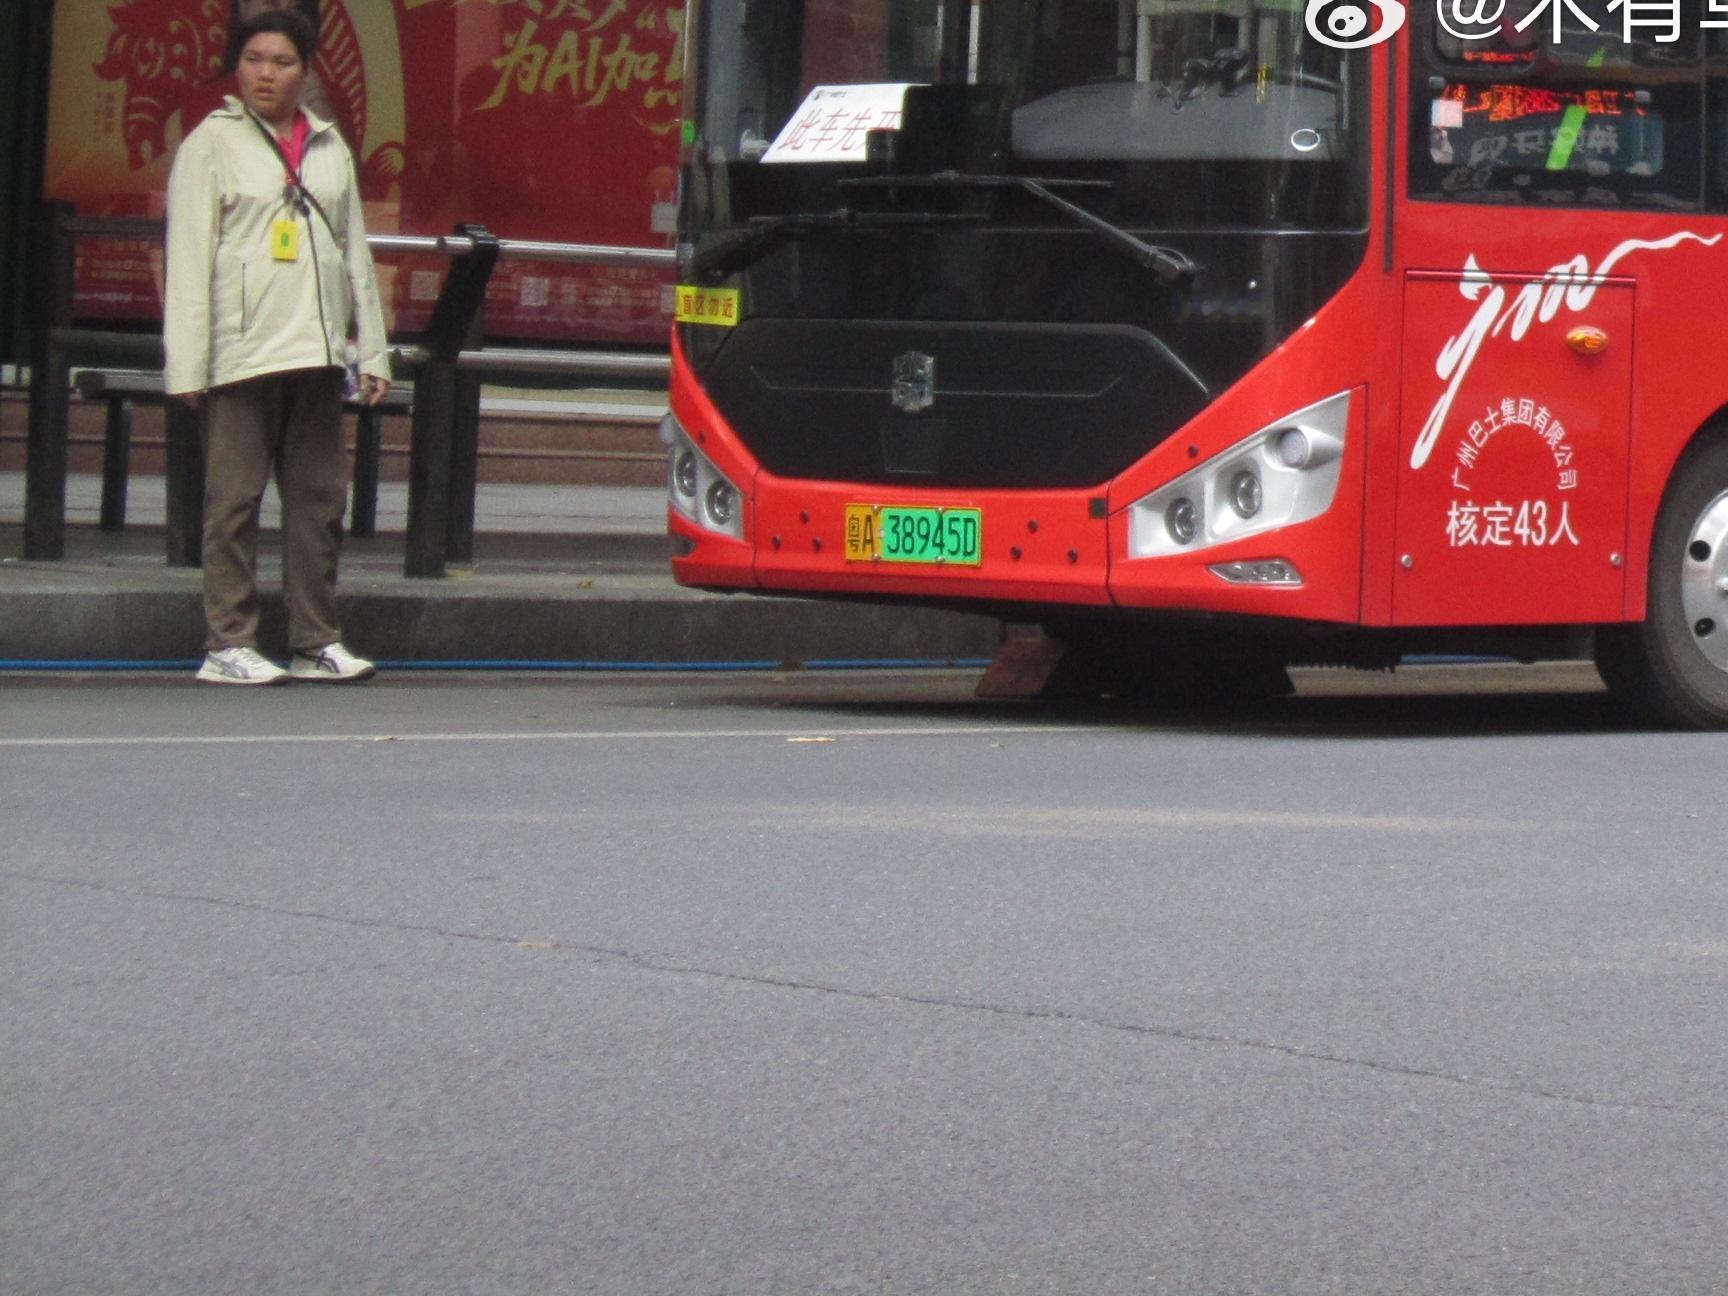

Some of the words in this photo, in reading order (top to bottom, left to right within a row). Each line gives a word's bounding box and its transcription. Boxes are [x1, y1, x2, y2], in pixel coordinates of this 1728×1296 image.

[1450, 397, 1577, 491] 广州巴士集团有限公司
[1445, 500, 1580, 547] 核定43人
